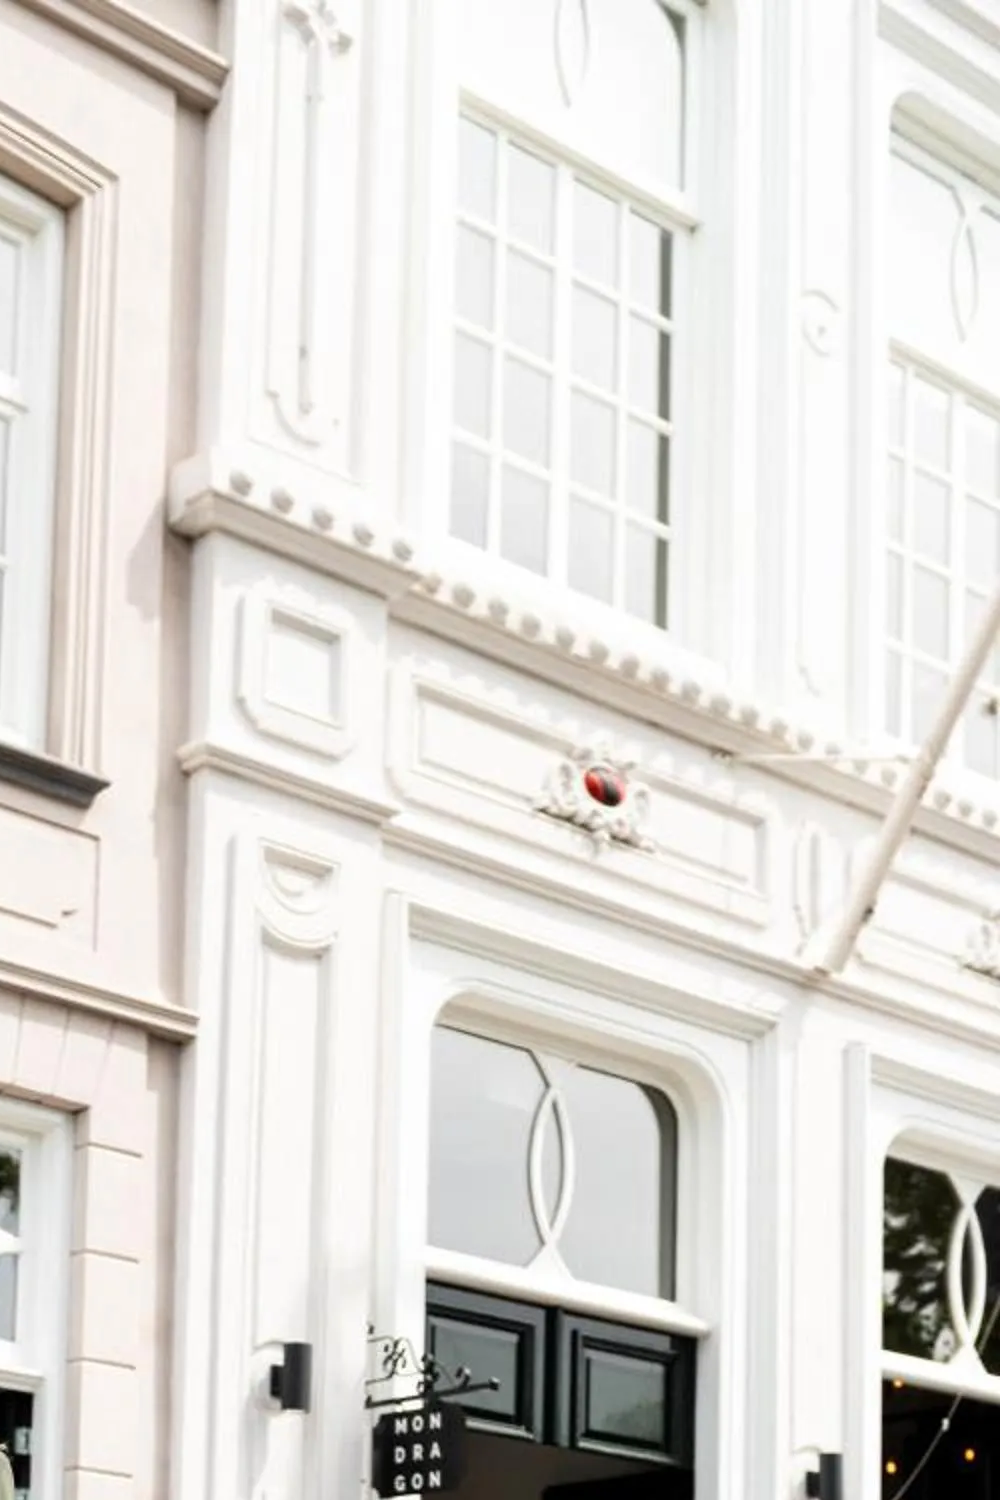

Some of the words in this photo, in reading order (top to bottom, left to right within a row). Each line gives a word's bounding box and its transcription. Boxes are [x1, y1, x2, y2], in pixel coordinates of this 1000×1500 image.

[395, 1412, 441, 1434] MON
[395, 1442, 441, 1463] DRA
[395, 1470, 441, 1491] GON
